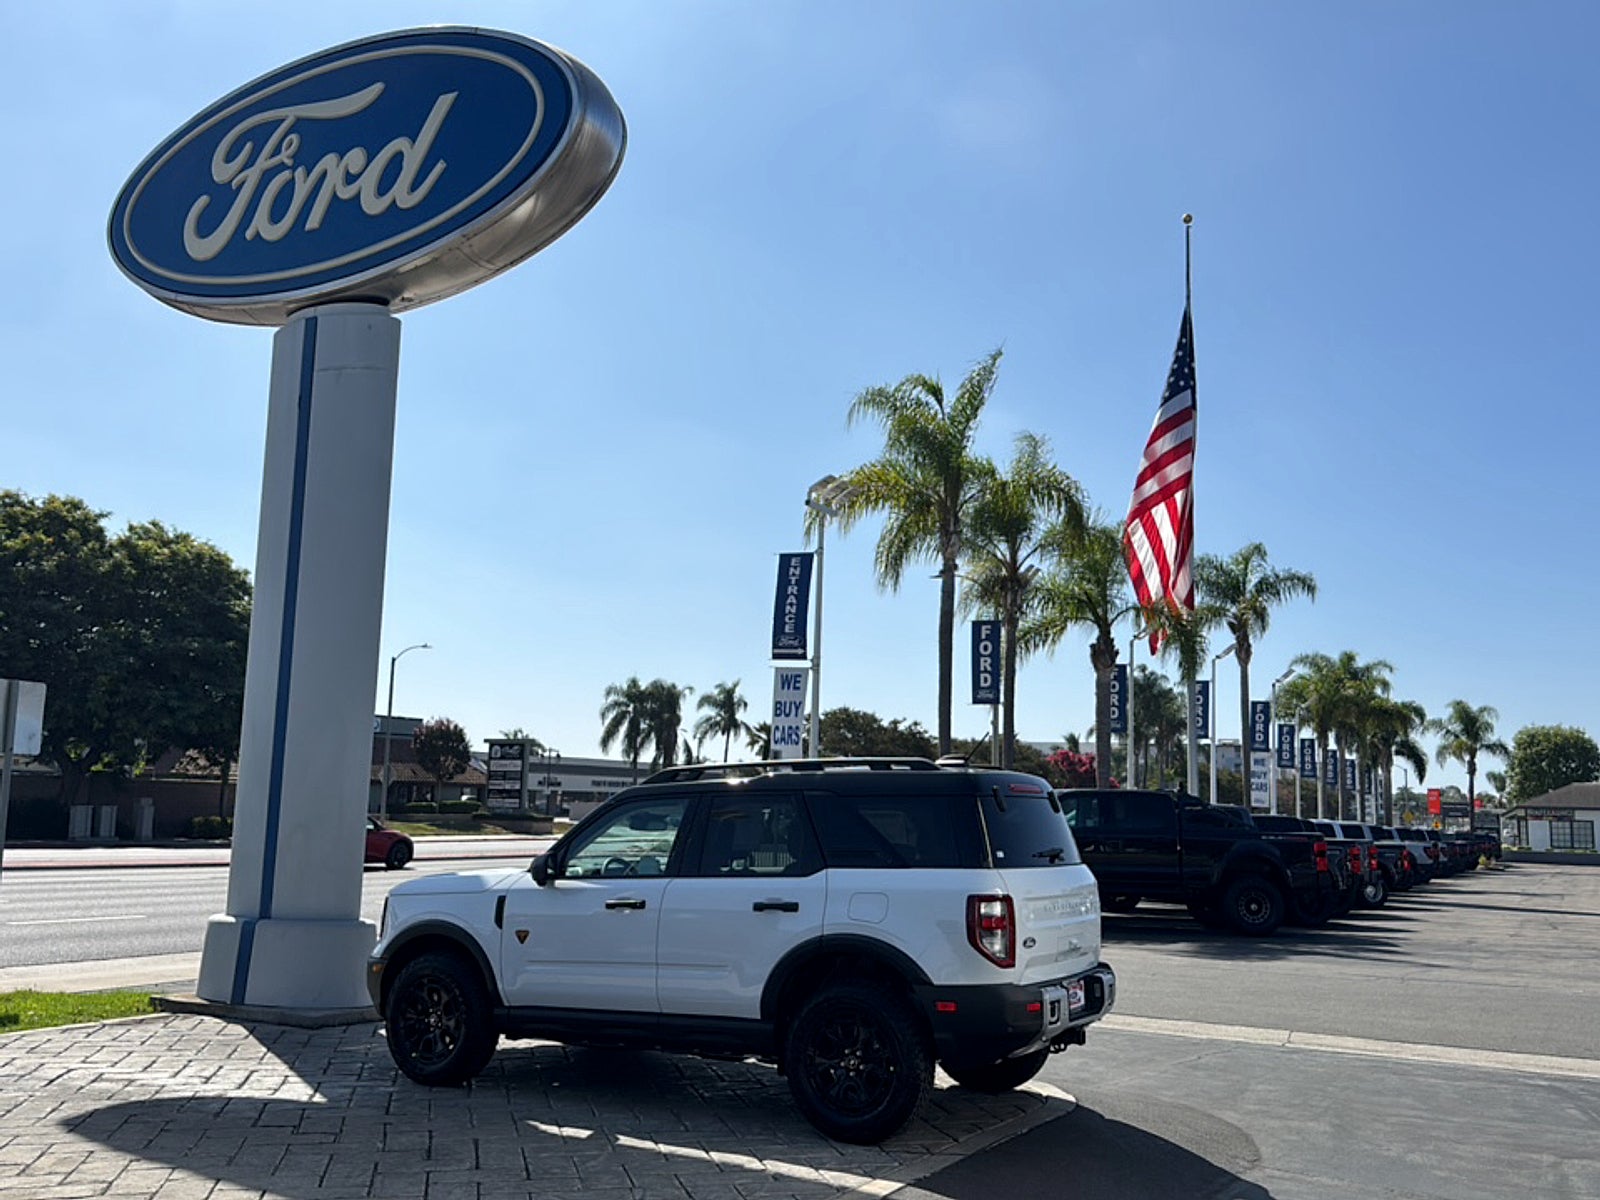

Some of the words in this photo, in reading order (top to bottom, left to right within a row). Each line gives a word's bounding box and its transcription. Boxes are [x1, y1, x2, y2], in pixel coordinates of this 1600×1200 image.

[182, 81, 459, 262] Ford
[784, 556, 801, 633] ENTRANCE
[979, 624, 993, 688] FORD
[780, 673, 802, 691] WE
[1110, 668, 1120, 719] FORD
[774, 700, 802, 718] BUY
[1255, 703, 1265, 742] FORD
[773, 724, 801, 746] CARS
[1281, 726, 1290, 760] FORD
[1303, 740, 1312, 770] FORD
